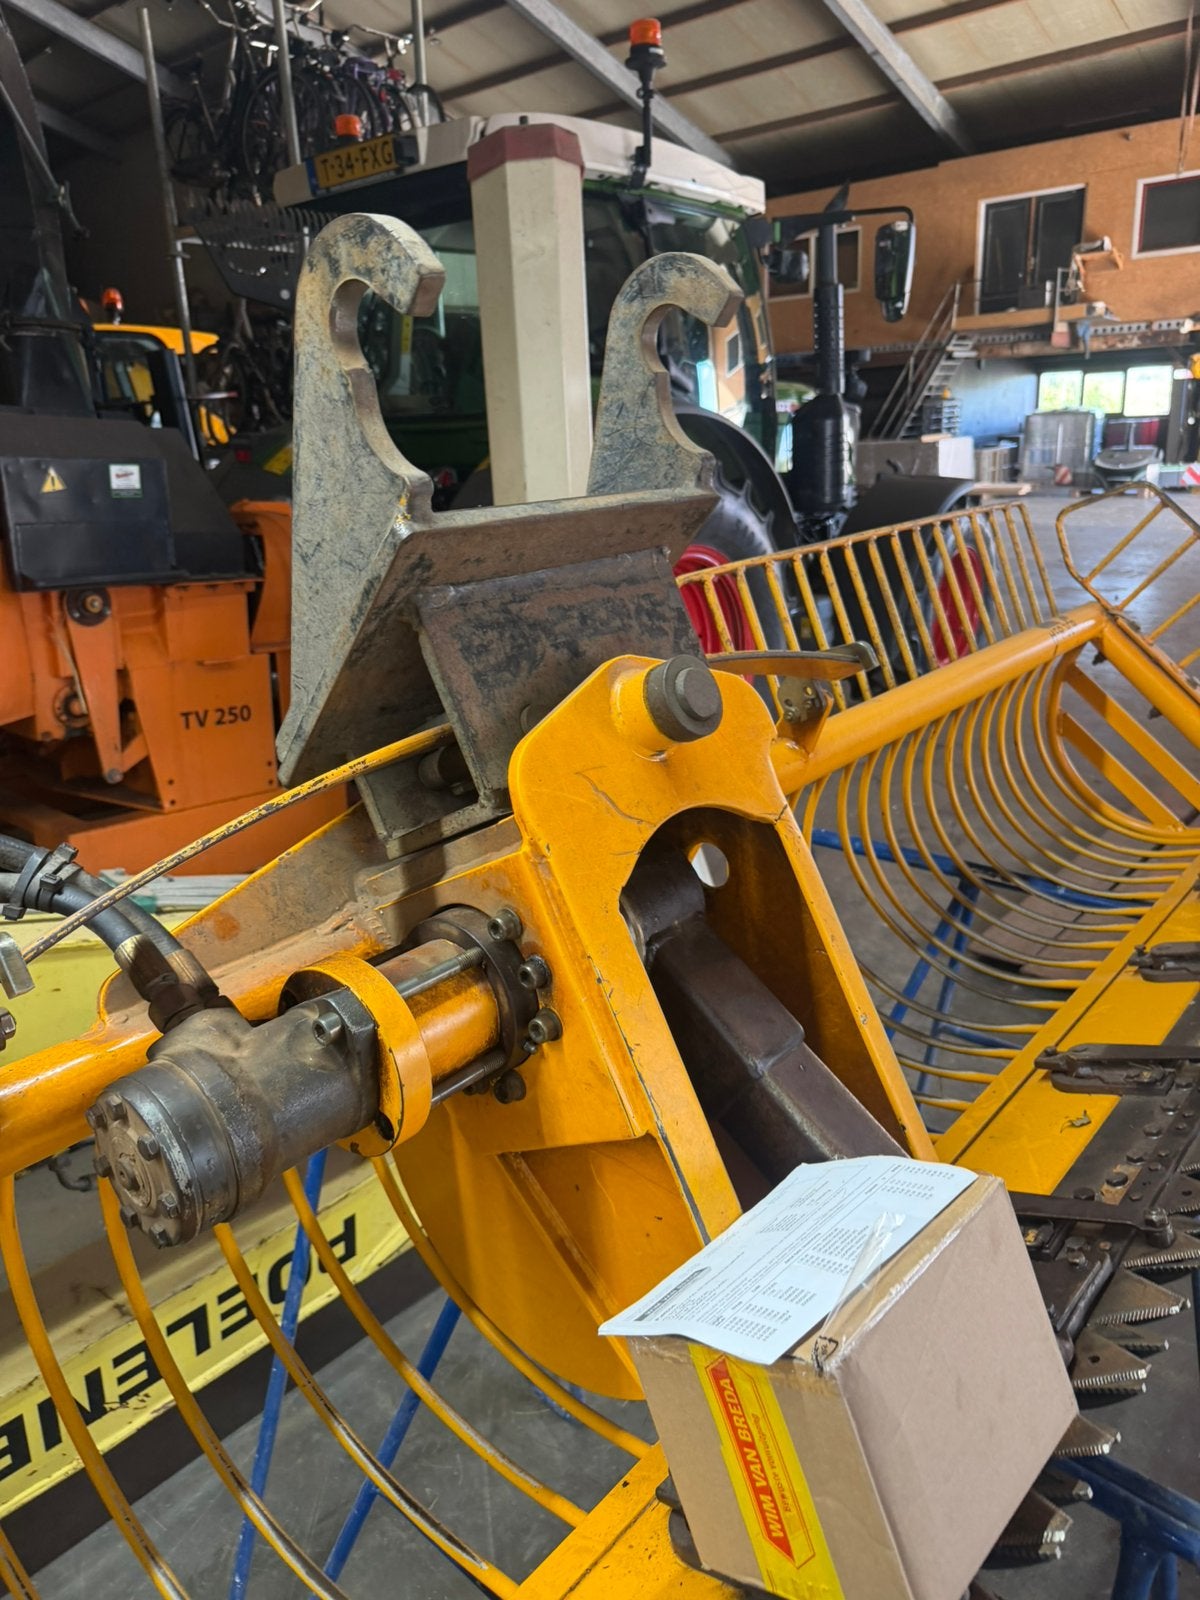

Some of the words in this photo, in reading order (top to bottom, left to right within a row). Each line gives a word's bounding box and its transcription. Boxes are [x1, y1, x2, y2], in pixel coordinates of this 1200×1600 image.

[179, 708, 209, 730] TV
[214, 704, 252, 726] 250
[719, 1378, 753, 1443] BREDA
[744, 1447, 768, 1488] VAN
[759, 1493, 784, 1538] WIM
